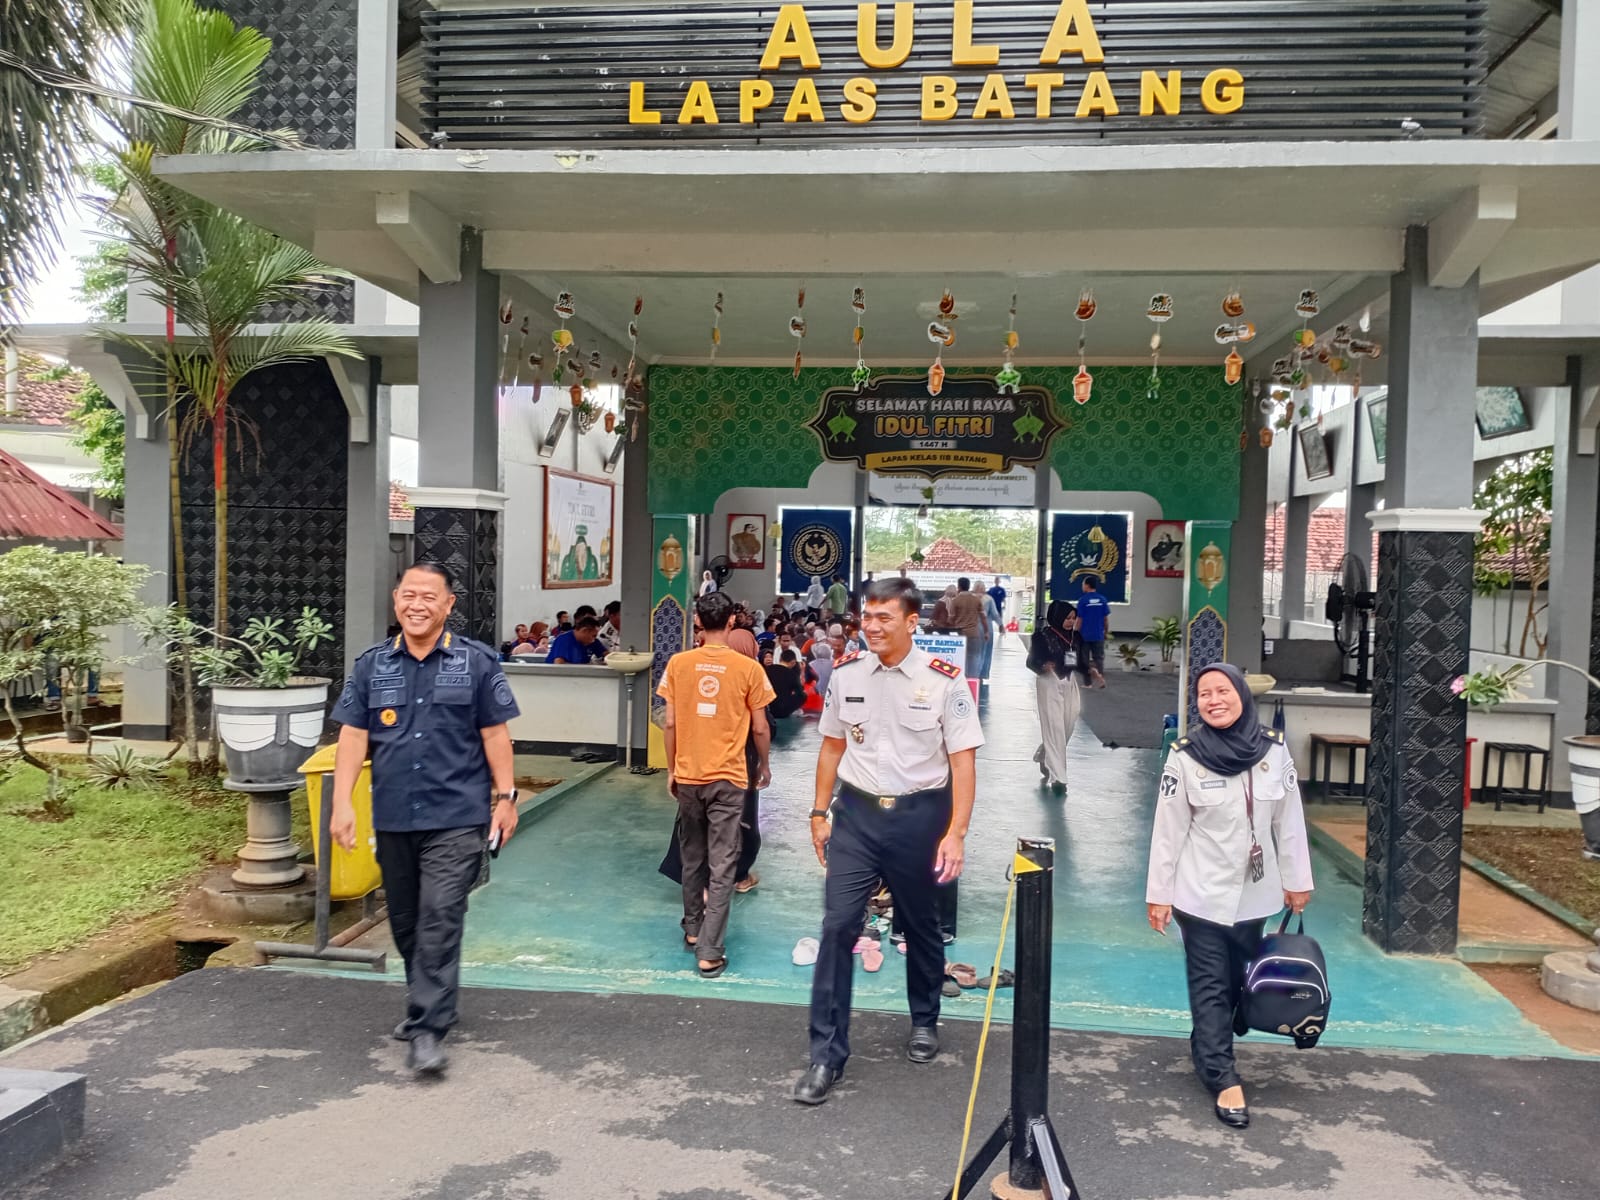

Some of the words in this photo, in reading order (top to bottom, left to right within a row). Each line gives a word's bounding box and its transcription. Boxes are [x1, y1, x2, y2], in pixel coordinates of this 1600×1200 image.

[760, 0, 1104, 68] AULA
[628, 77, 877, 124] LAPAS
[920, 68, 1245, 121] BATANG
[856, 399, 928, 412] SELAMAT
[931, 399, 970, 412] HARI
[973, 399, 1014, 412] RAYA
[876, 416, 929, 436] IDUL
[933, 416, 992, 436] FITRI
[881, 455, 908, 464] LAPAS
[953, 454, 988, 464] BATANG
